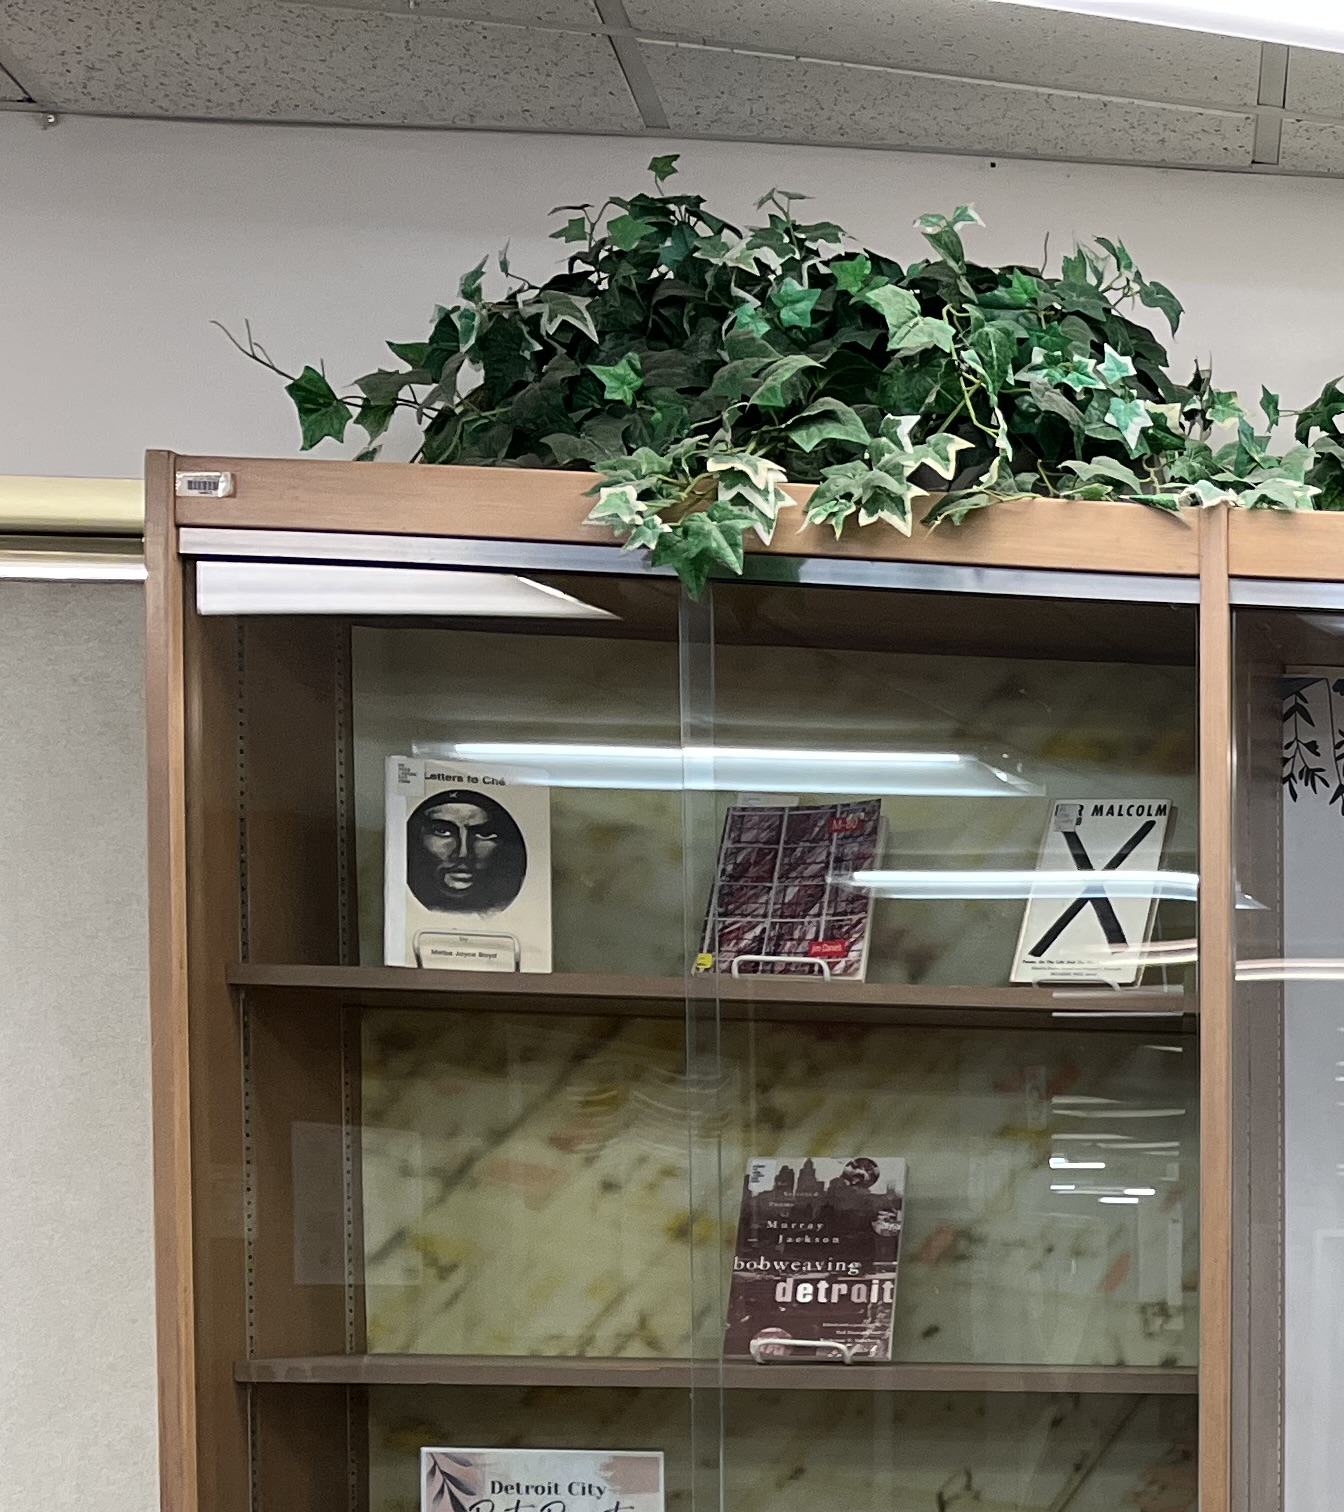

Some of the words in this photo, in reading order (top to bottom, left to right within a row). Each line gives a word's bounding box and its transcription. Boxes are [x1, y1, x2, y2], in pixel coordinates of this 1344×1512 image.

[467, 774, 479, 784] to
[1091, 804, 1168, 816] MALCOLM
[766, 1220, 825, 1232] Murray
[777, 1235, 840, 1244] Jackson
[733, 1256, 862, 1276] bobweaving
[775, 1278, 894, 1304] detroit
[490, 1480, 559, 1496] Detroit
[567, 1481, 607, 1499] City
